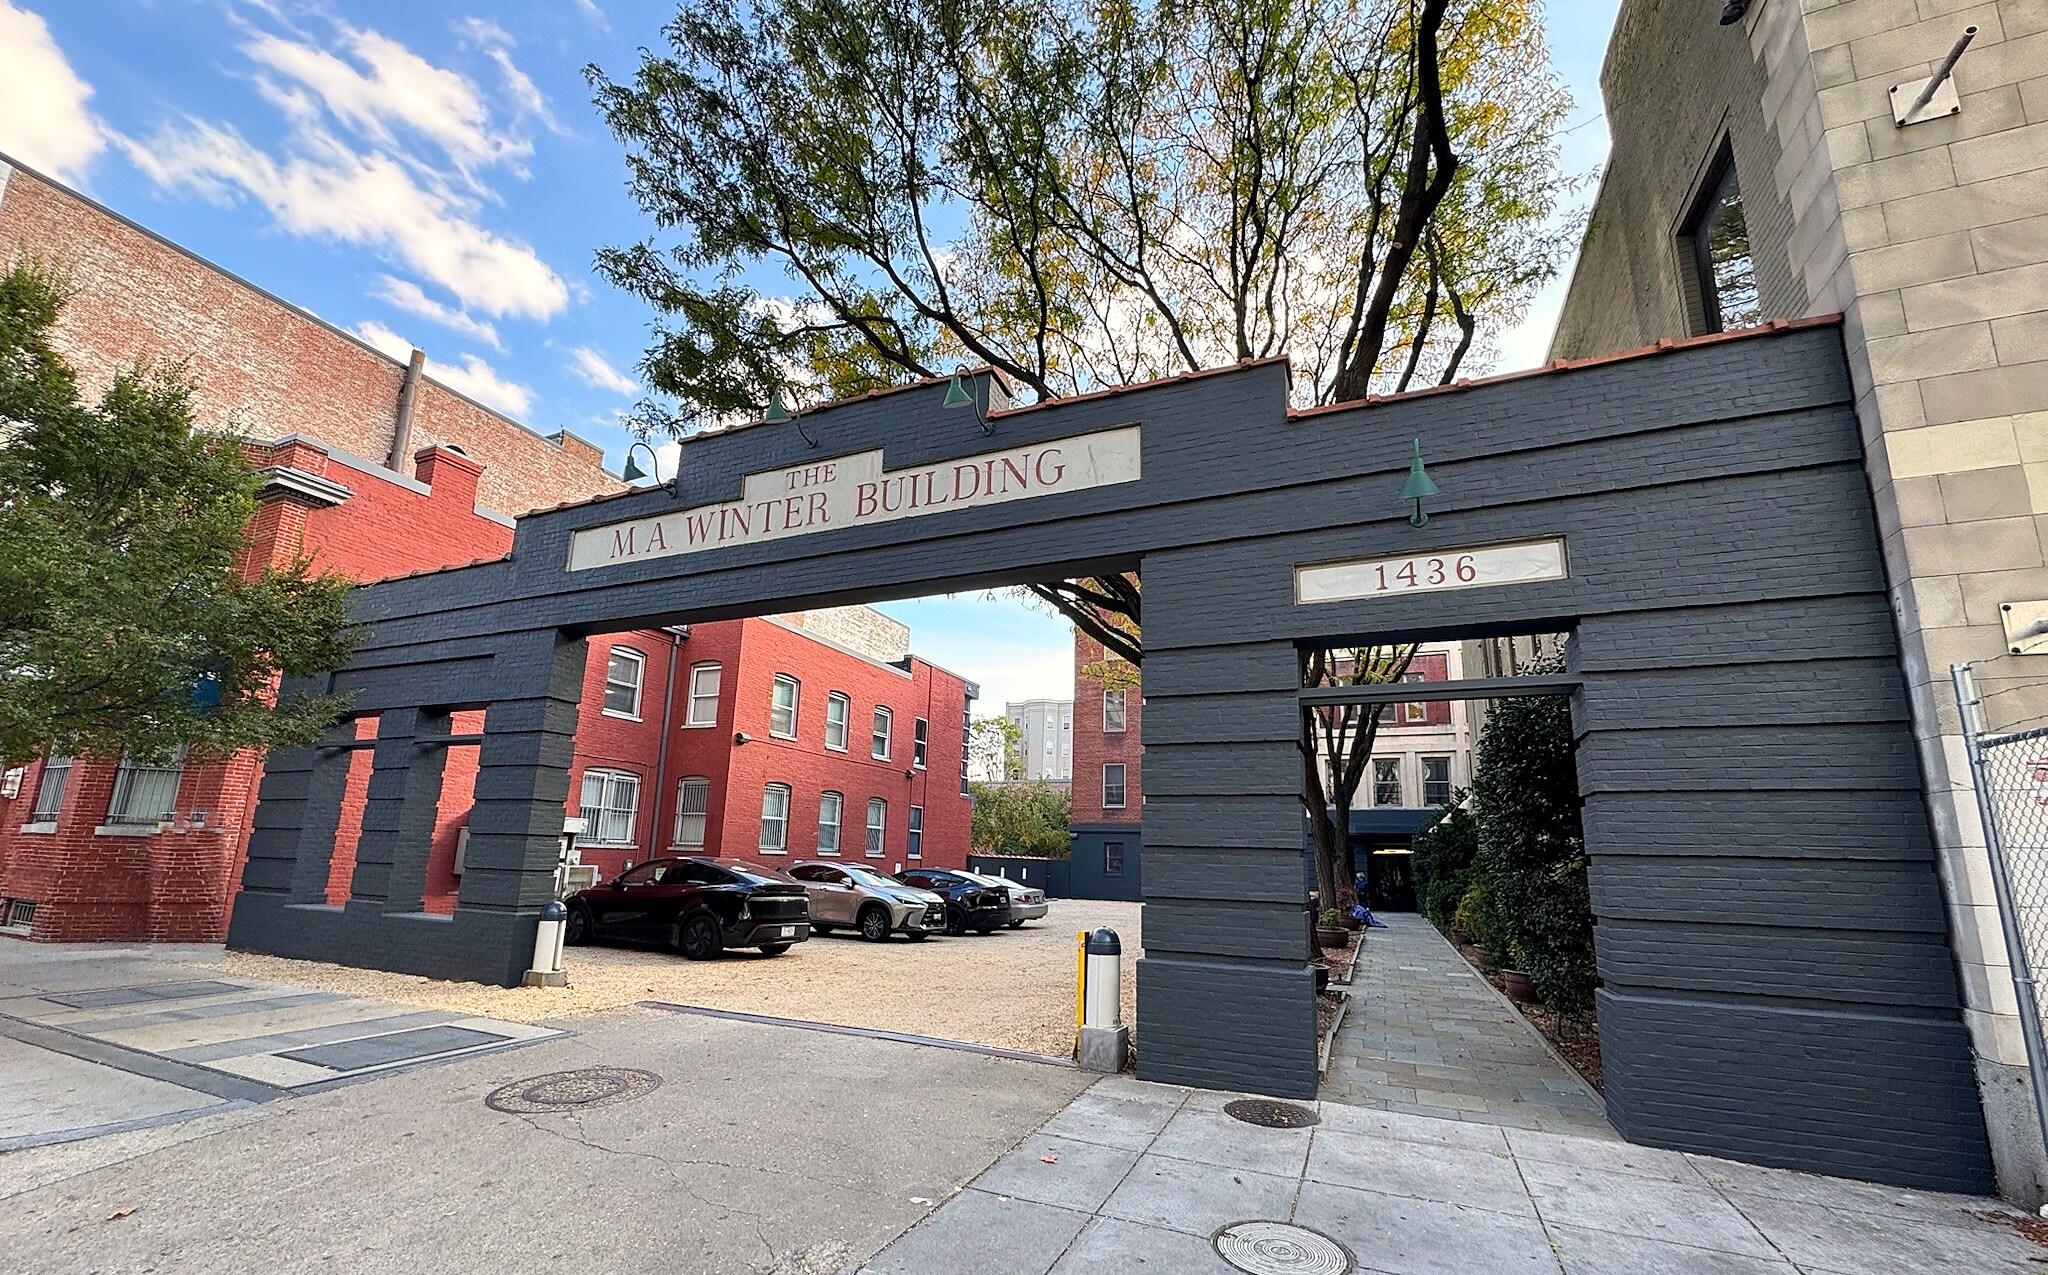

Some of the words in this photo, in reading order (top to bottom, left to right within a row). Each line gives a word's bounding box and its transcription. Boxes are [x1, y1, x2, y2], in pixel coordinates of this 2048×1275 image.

[785, 463, 837, 490] THE
[686, 492, 831, 546] WINTER
[855, 448, 1066, 518] BUILDING
[1375, 555, 1476, 591] 1436
